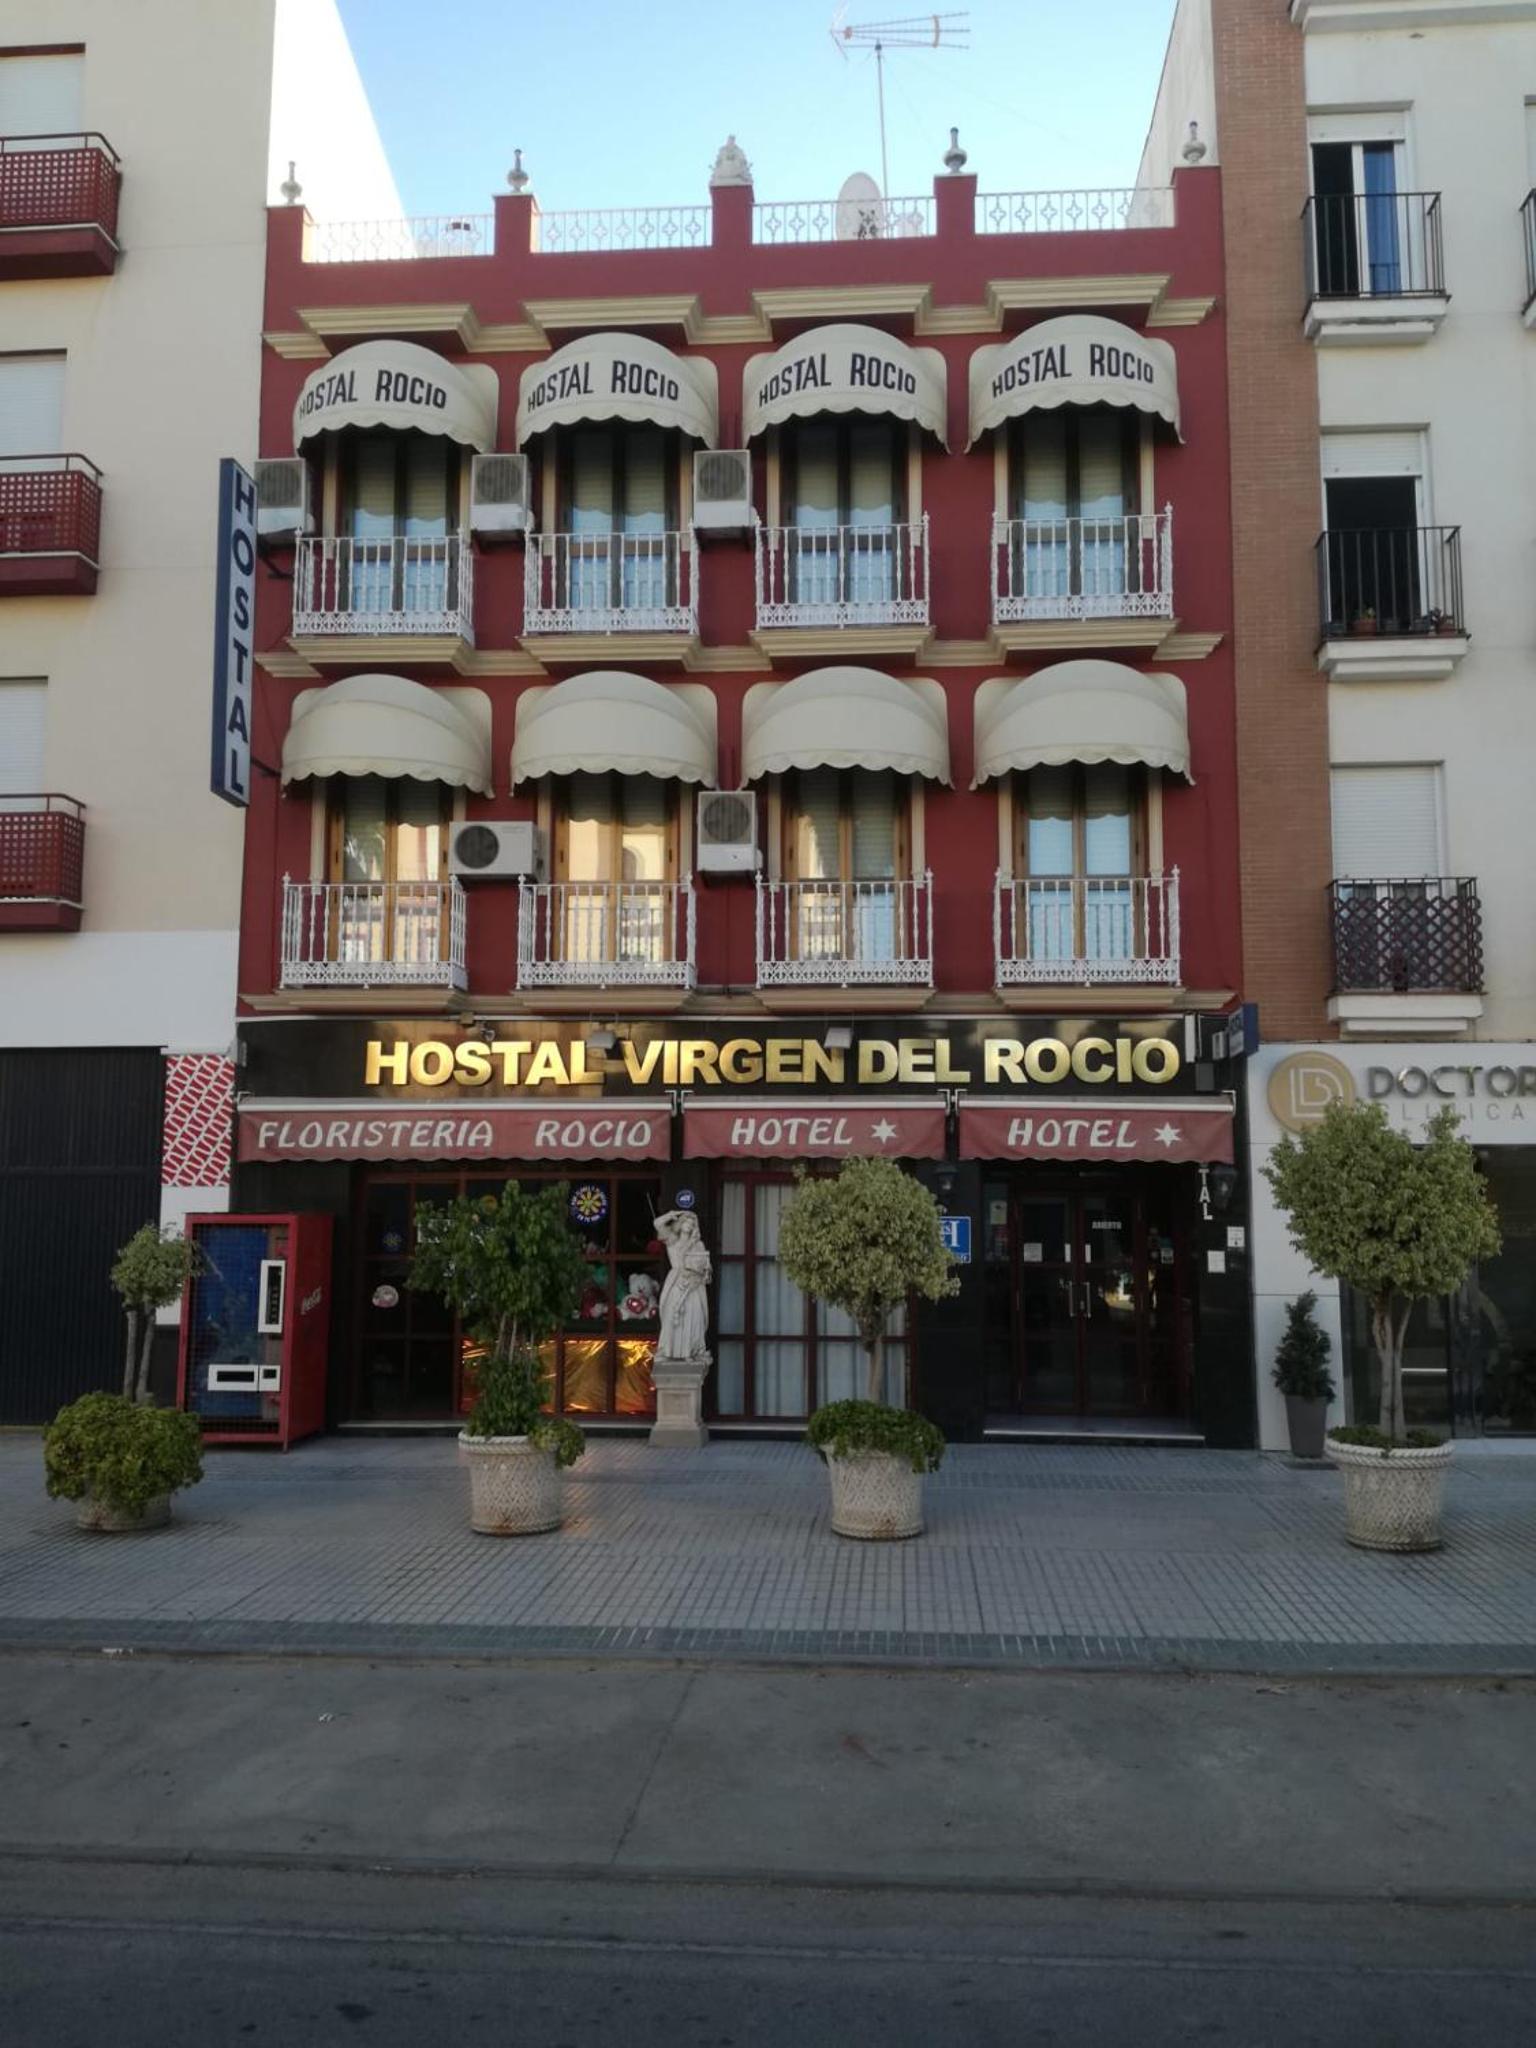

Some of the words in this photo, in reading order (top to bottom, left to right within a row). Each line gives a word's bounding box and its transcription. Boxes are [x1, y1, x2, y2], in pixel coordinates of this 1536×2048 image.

[299, 370, 358, 418] HOSTAL
[375, 369, 448, 410] ROCIO
[527, 361, 594, 413] HOSTAL
[611, 359, 679, 400] ROCIO
[758, 353, 832, 407] HOSTAL
[850, 352, 917, 395] ROCIO
[991, 343, 1072, 399] HOSTAL
[1089, 342, 1155, 385] ROCIO
[227, 467, 255, 795] HOSTAL
[364, 1040, 606, 1086] HOSTAL
[621, 1039, 845, 1085] VIRGEN
[858, 1038, 971, 1084] DEL
[984, 1036, 1181, 1085] ROCIO
[257, 1120, 494, 1150] FLORISTERIA
[534, 1120, 652, 1149] ROCIO
[730, 1117, 854, 1146] HOTEL
[1006, 1117, 1138, 1149] HOTEL
